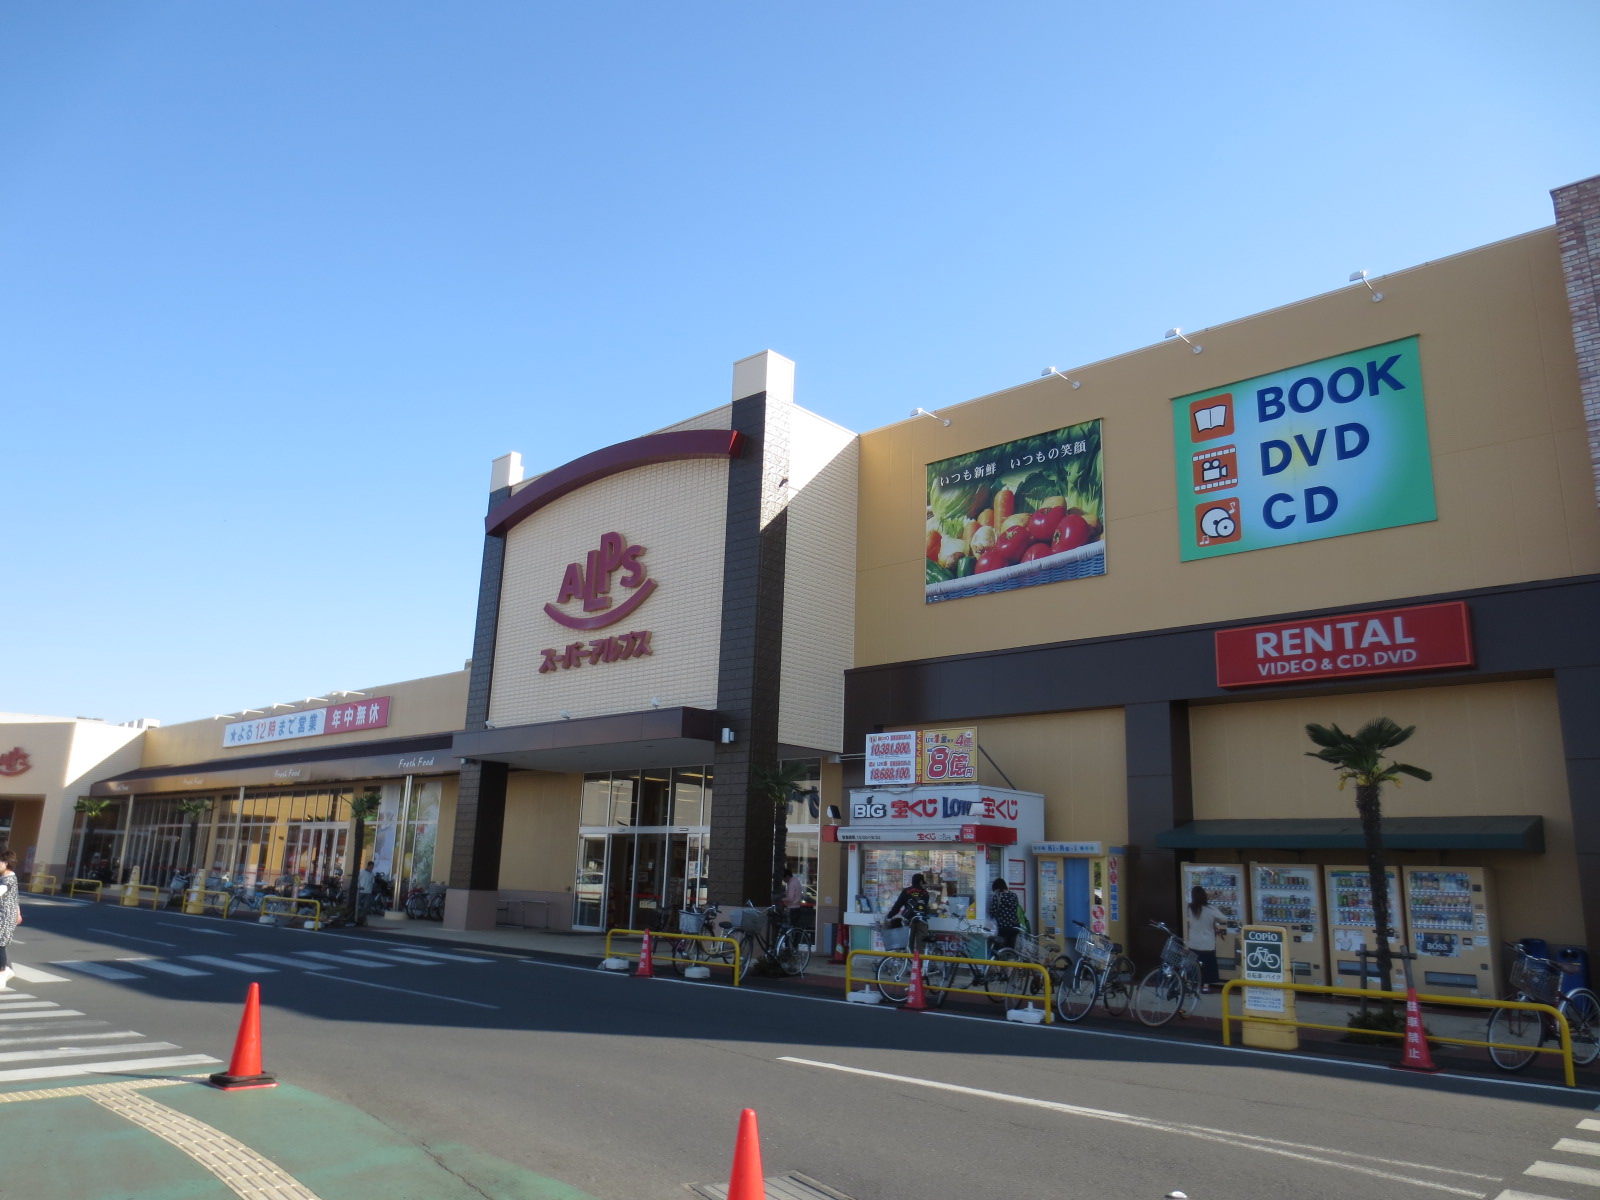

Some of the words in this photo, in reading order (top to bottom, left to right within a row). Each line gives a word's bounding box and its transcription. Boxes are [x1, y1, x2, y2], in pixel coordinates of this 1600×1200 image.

[1257, 354, 1406, 422] BOOK
[940, 462, 997, 487] いつも新鮮
[1010, 439, 1087, 470] いつもの笑顔
[1260, 422, 1370, 476] DVD
[1263, 485, 1339, 530] CD
[557, 531, 648, 613] ALPS
[538, 630, 653, 673] スーパーアルプス
[1255, 616, 1416, 659] RENTAL
[1257, 658, 1317, 677] VIDEO
[1320, 657, 1334, 671] &
[332, 703, 380, 729] 年中無休
[398, 757, 416, 768] Fresh
[417, 756, 435, 767] Food
[854, 803, 886, 818] BIG
[890, 798, 937, 818] 宝くじ
[942, 796, 971, 818] LOT
[981, 797, 1018, 820] 宝くじ
[1426, 942, 1449, 951] BOSS
[1406, 1001, 1420, 1059] 駐車禁止
